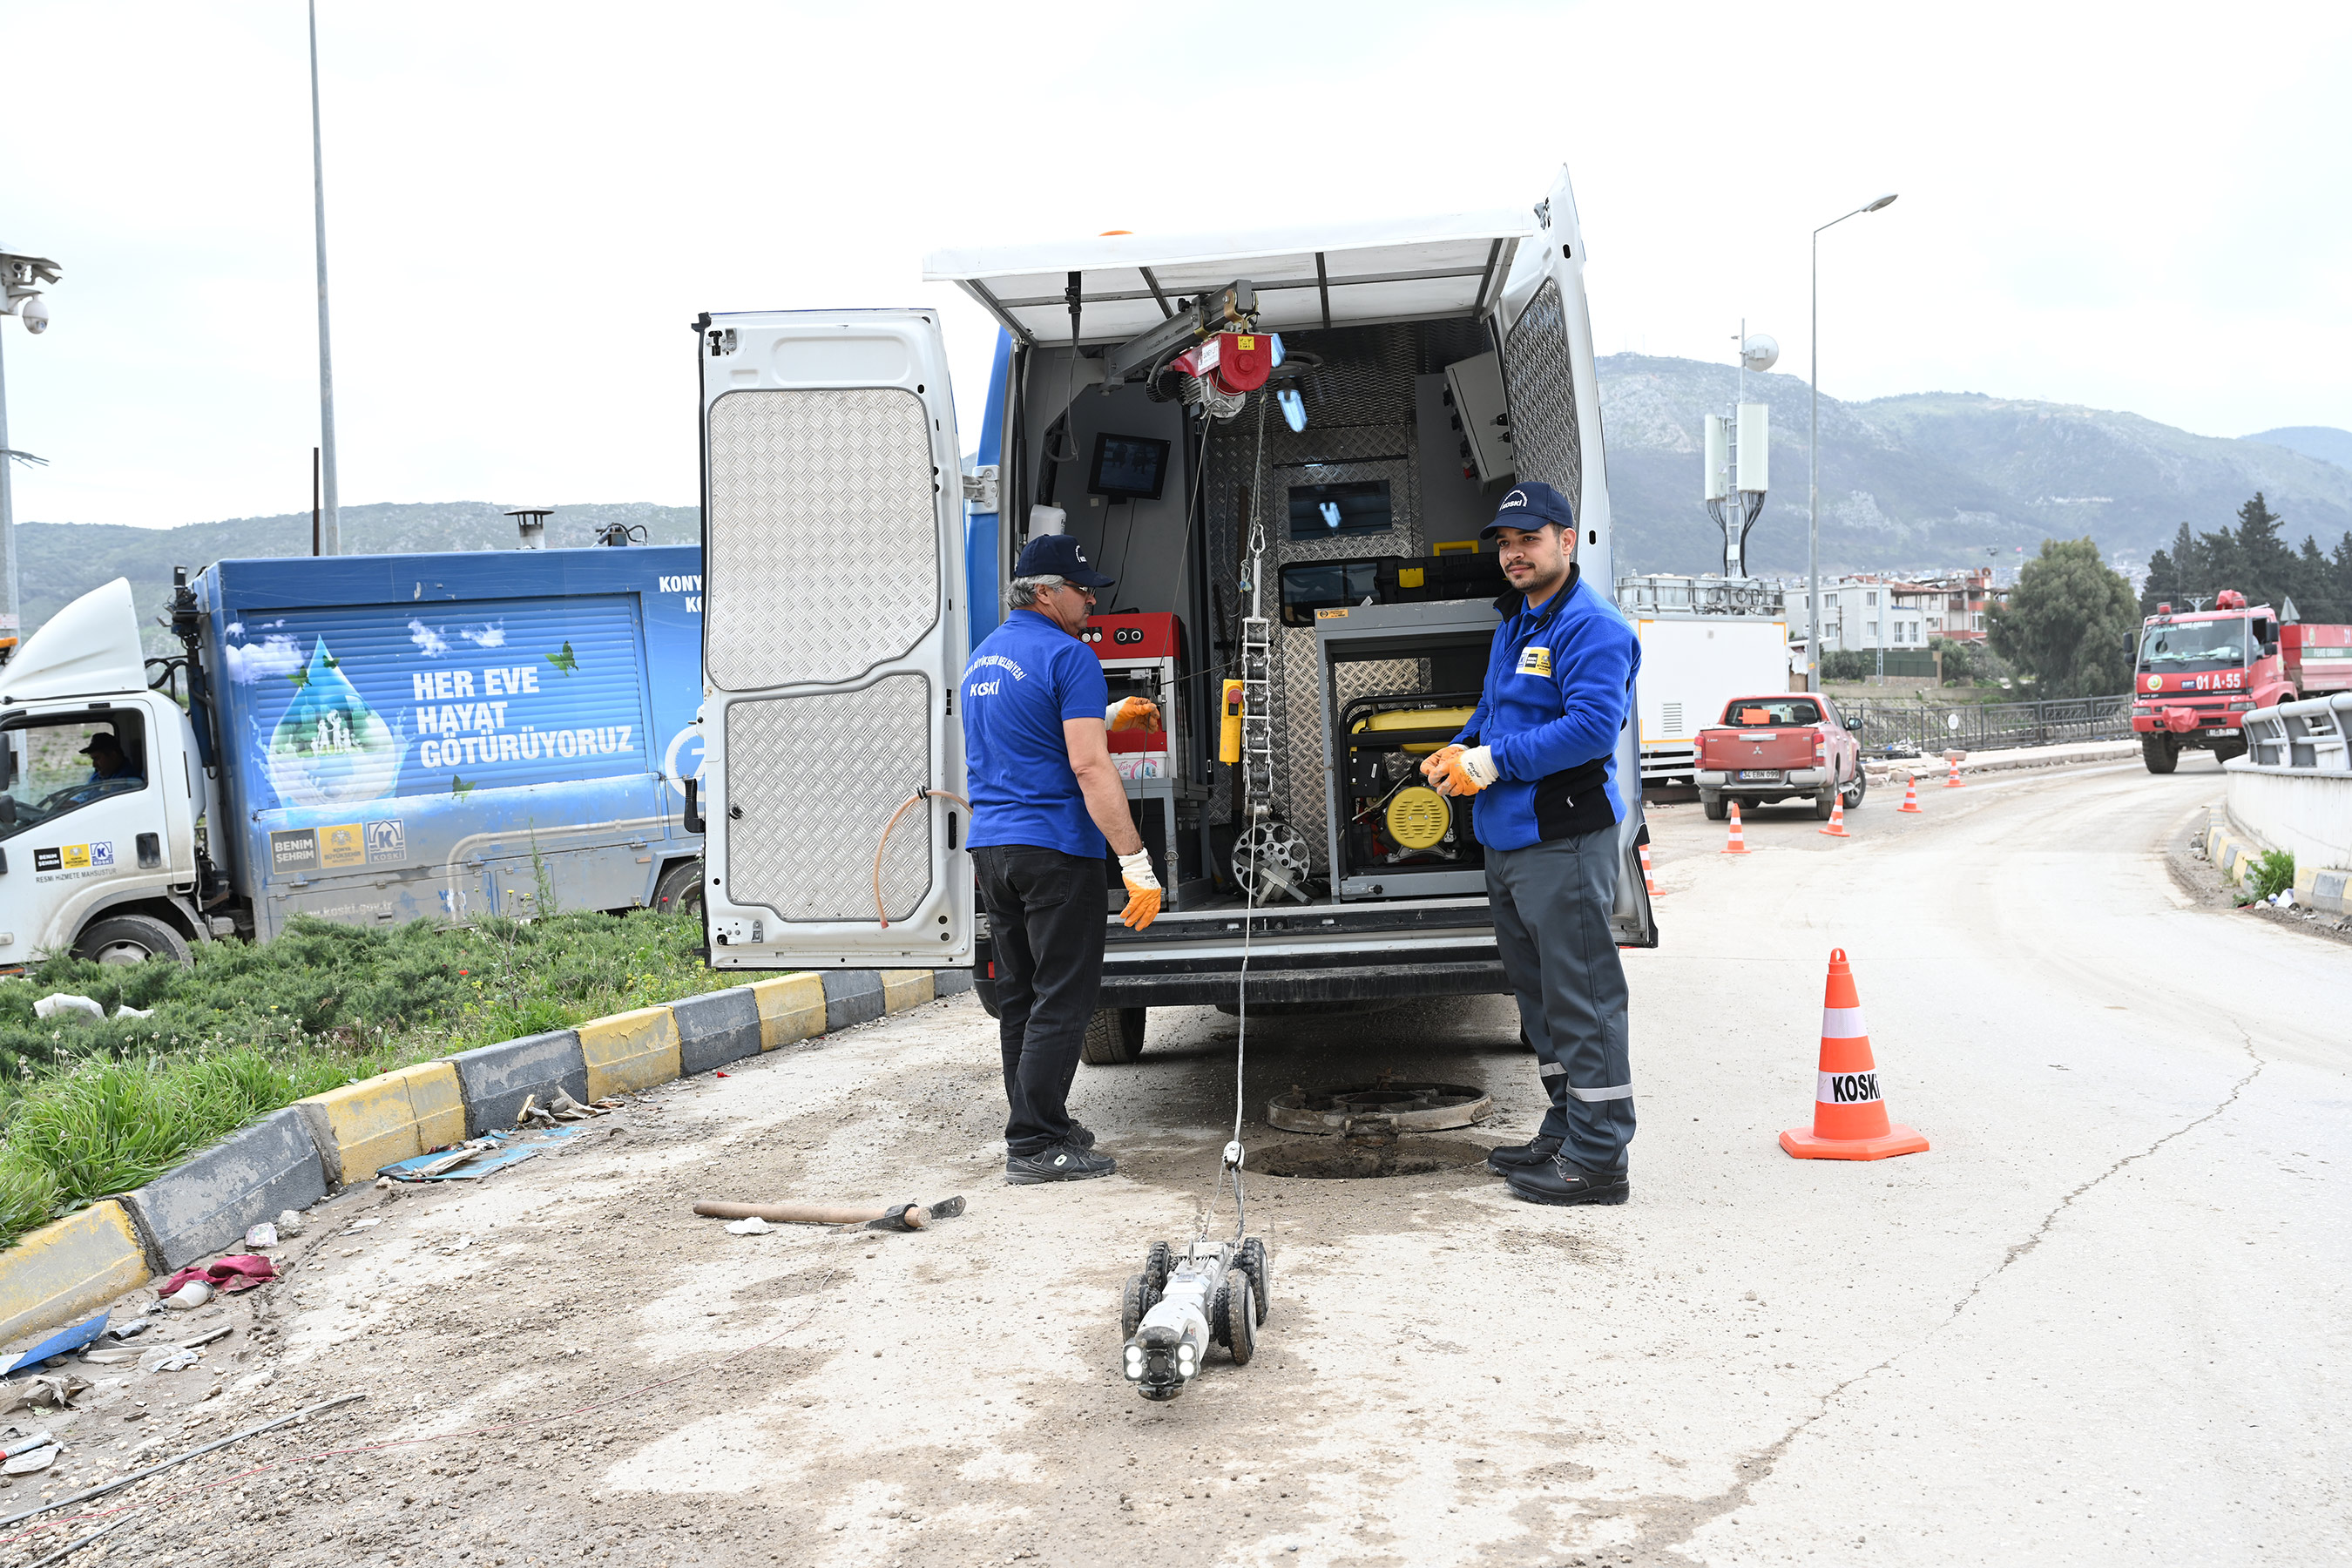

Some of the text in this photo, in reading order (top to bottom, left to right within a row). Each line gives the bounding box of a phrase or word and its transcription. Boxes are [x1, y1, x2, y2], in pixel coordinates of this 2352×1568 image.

[412, 666, 540, 701] HER EVE
[2196, 674, 2209, 690] 01
[416, 701, 508, 734] HAYAT
[420, 726, 634, 768] GÖTÜRÜYORUZ
[1742, 769, 1778, 779] 34 EBN 099
